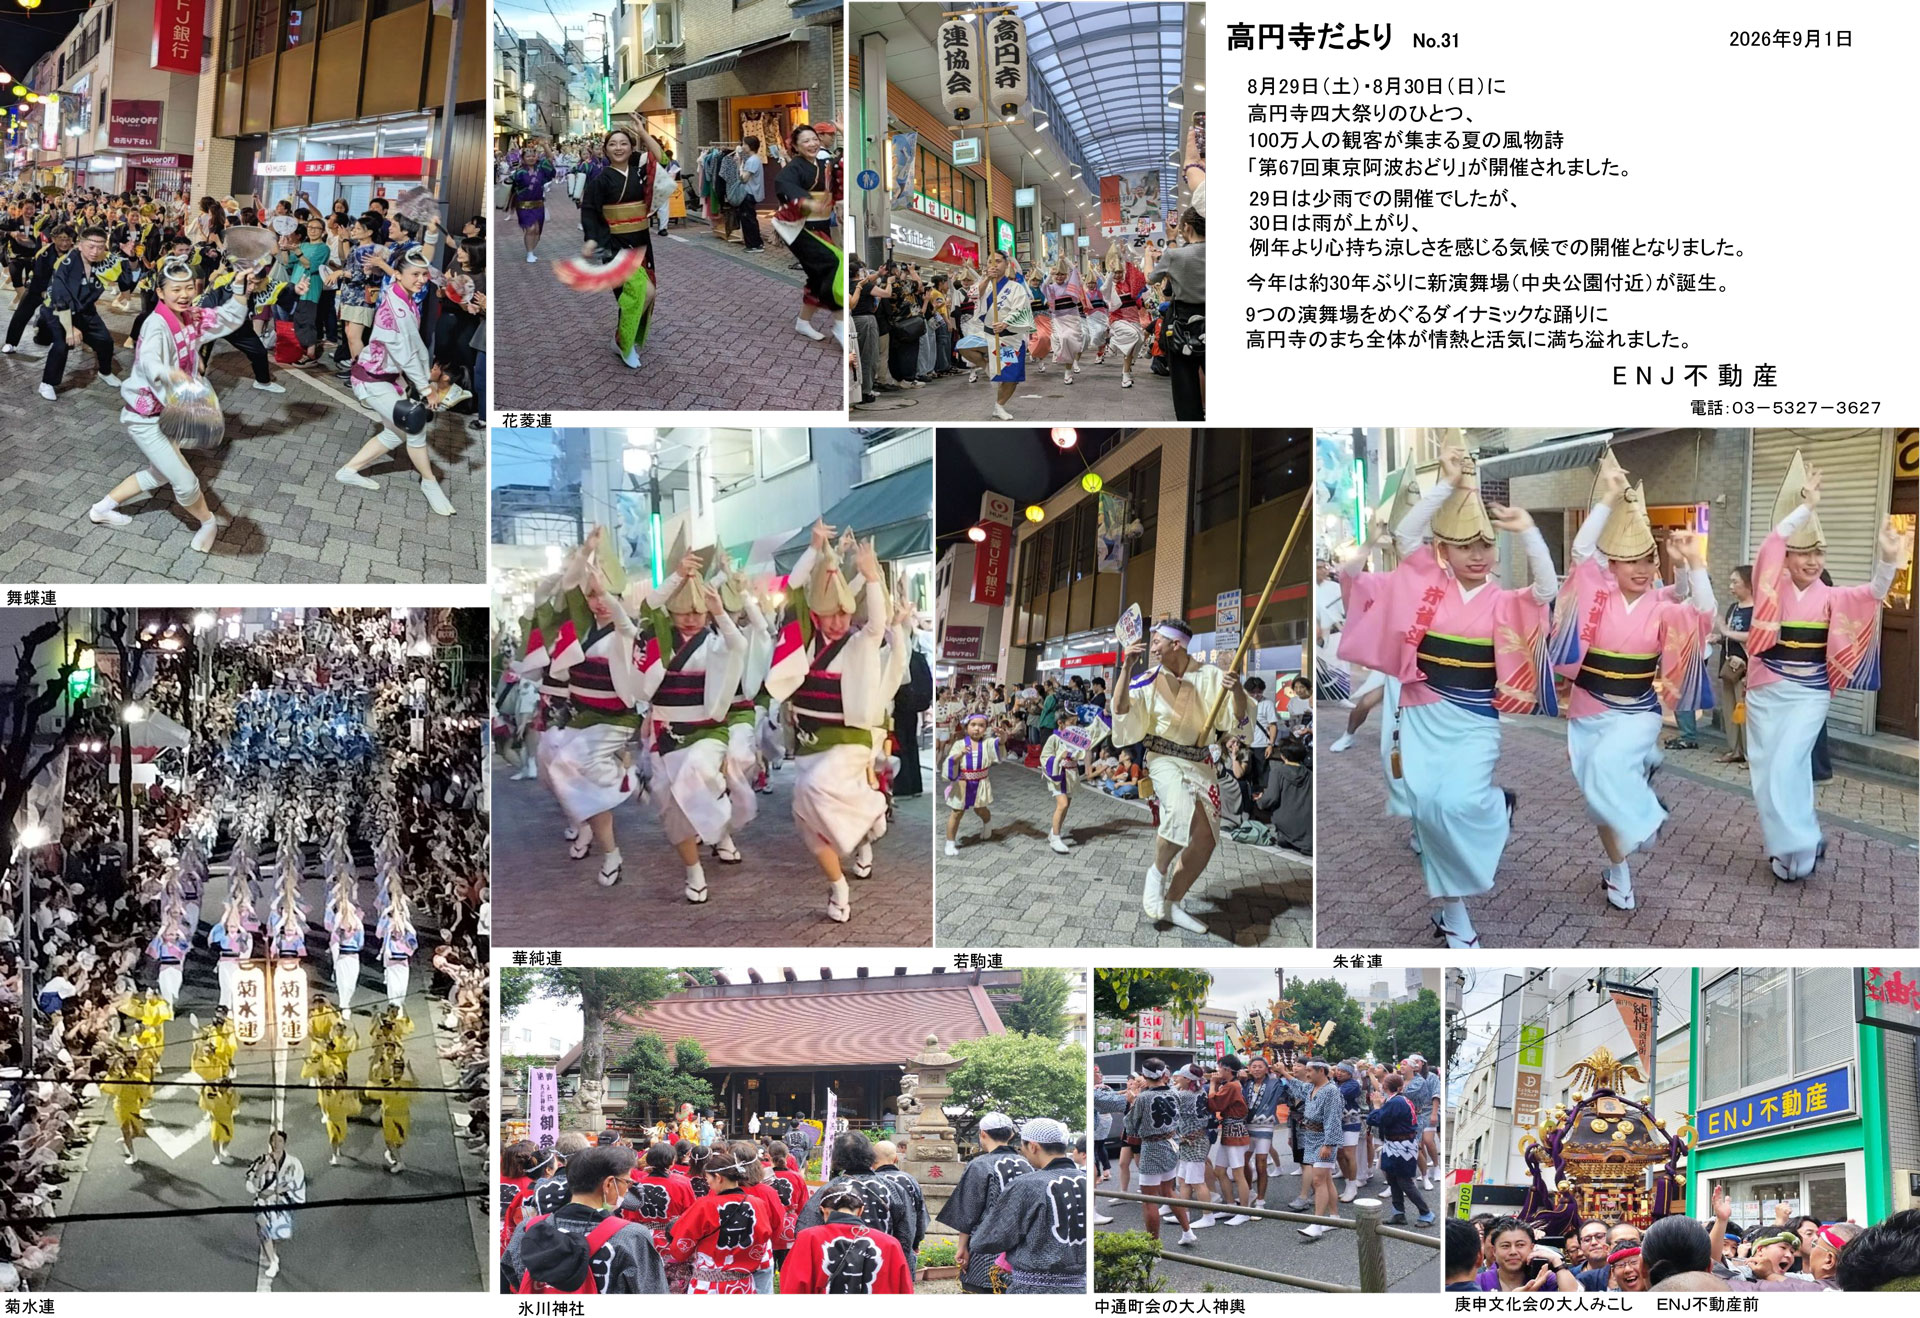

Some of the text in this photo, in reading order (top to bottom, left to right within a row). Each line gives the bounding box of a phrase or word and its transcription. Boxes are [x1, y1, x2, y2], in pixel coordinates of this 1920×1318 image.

[942, 24, 972, 95] 連協会
[993, 19, 1021, 89] 高円寺
[112, 115, 158, 124] Liquor OFF
[113, 137, 152, 145] お売り下さい
[142, 156, 162, 164] Liquor
[163, 156, 175, 164] OFF
[237, 980, 258, 1038] 菊水連
[280, 981, 301, 1038] 菊水連
[1708, 1082, 1828, 1135] ENJ不動産
[1460, 1187, 1471, 1215] GOLF
